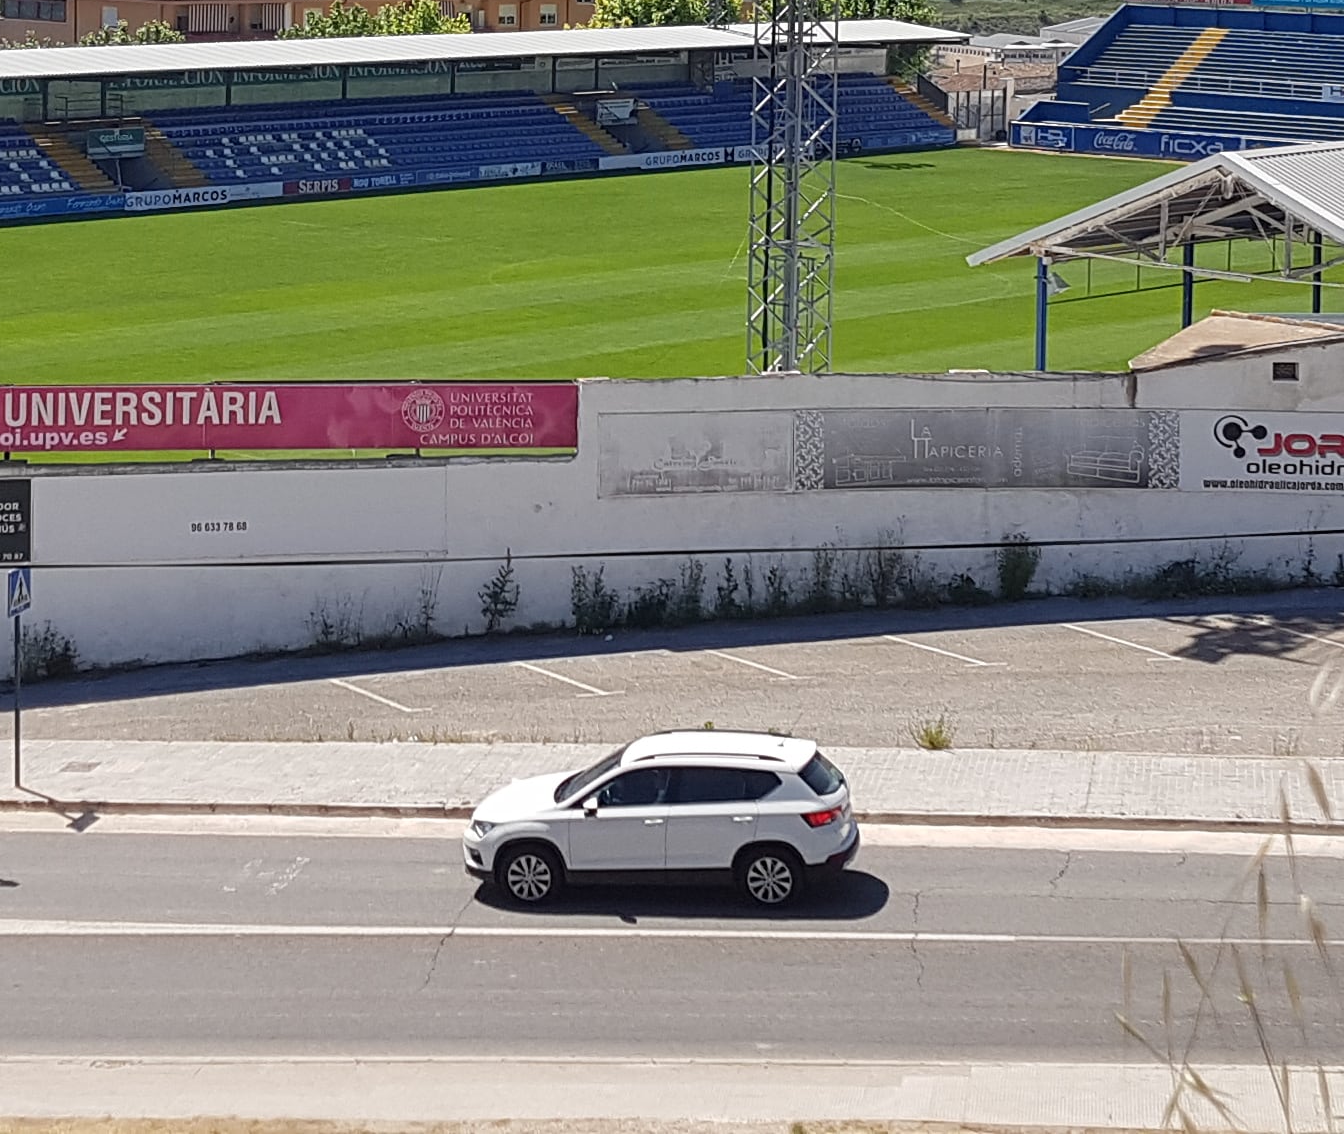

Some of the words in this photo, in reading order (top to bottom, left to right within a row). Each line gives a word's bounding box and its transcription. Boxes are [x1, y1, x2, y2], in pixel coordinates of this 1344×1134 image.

[298, 177, 339, 194] SERPIS
[449, 392, 534, 403] UNIVERSITAT
[450, 418, 465, 429] DE
[419, 433, 476, 445] CAMPUS
[481, 433, 534, 444] D'ALCOI
